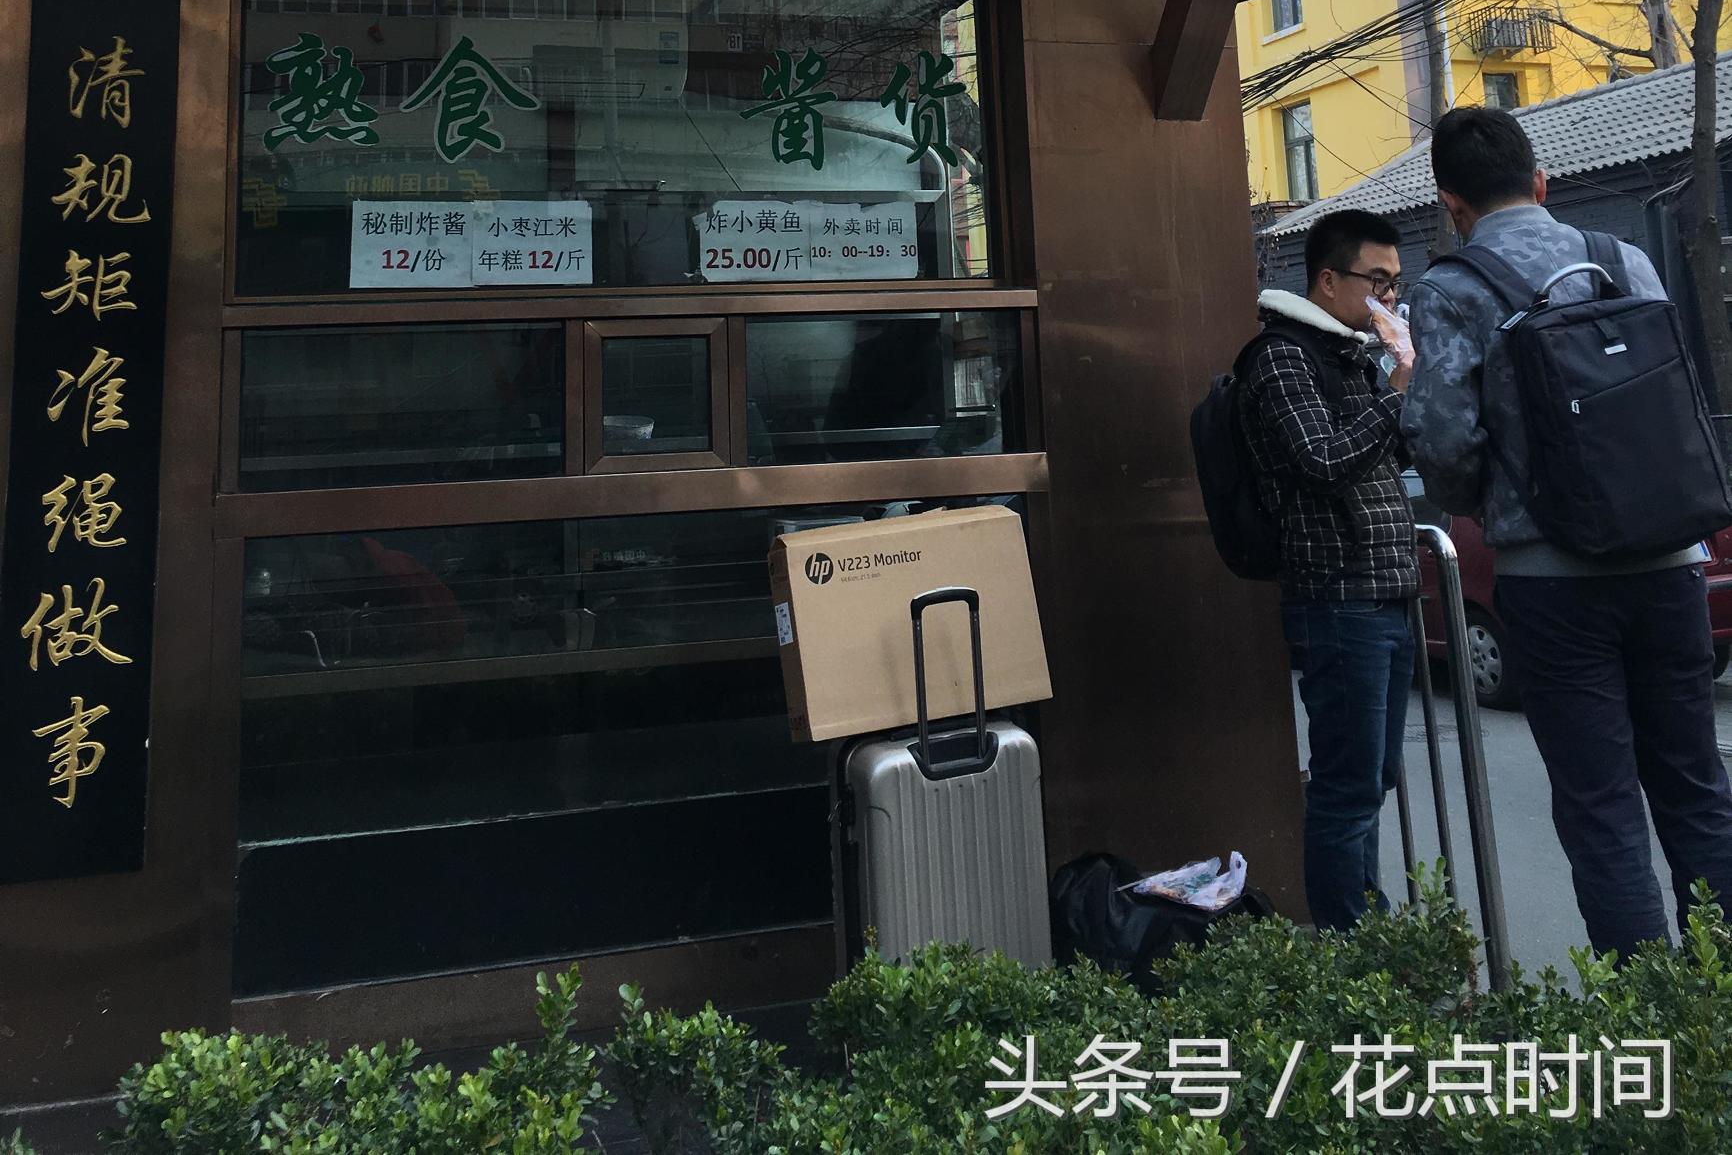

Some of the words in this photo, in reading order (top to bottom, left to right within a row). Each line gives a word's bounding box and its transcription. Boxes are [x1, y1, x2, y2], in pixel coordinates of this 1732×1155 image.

[264, 32, 541, 163] 熟食
[361, 211, 466, 237] 秘制炸酱
[487, 217, 577, 238] 小枣江米
[705, 209, 803, 235] 炸小黄鱼
[822, 217, 904, 237] 外卖时间
[381, 248, 446, 273] 12/份
[705, 247, 804, 271] 25.00/斤
[805, 552, 834, 585] hp
[838, 554, 871, 573] V223
[874, 549, 922, 568] Monitor
